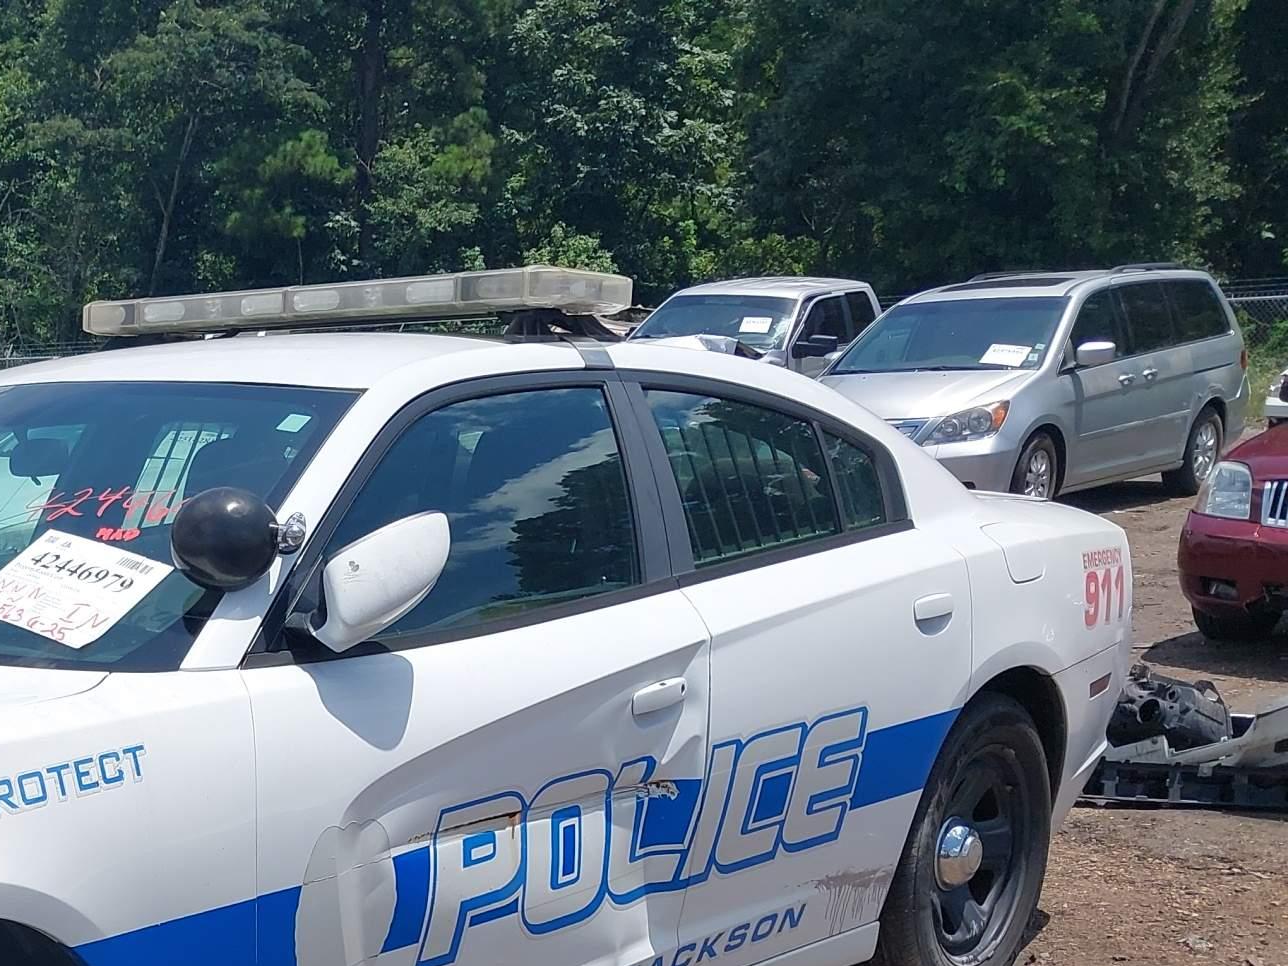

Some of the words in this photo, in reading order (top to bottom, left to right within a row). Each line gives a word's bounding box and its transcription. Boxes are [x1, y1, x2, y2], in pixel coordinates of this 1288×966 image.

[30, 551, 134, 593] 42446979
[1082, 547, 1123, 569] EMERGENCY
[1084, 566, 1125, 629] 911
